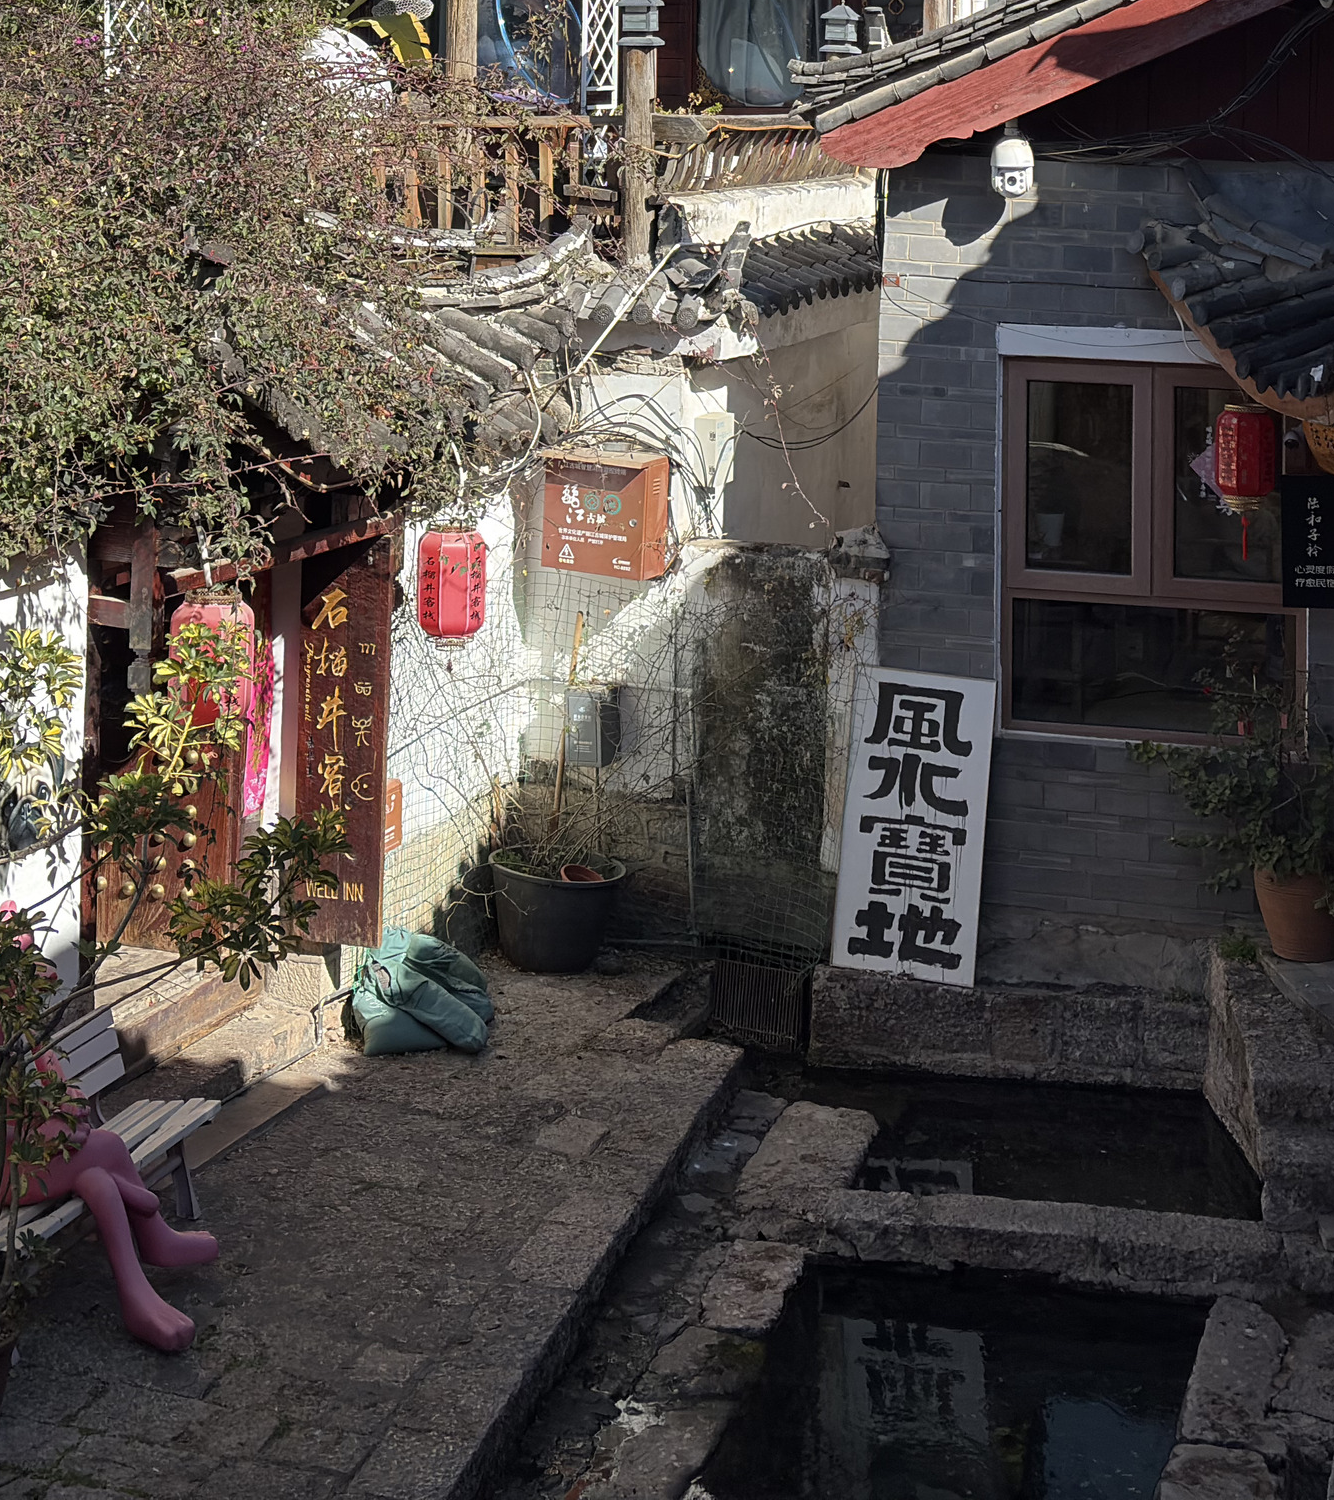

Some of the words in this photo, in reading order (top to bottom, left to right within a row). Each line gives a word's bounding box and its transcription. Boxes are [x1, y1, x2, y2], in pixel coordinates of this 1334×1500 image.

[422, 556, 436, 622] 石榴井客栈
[846, 681, 973, 970] 風水寶地
[343, 882, 365, 903] INN
